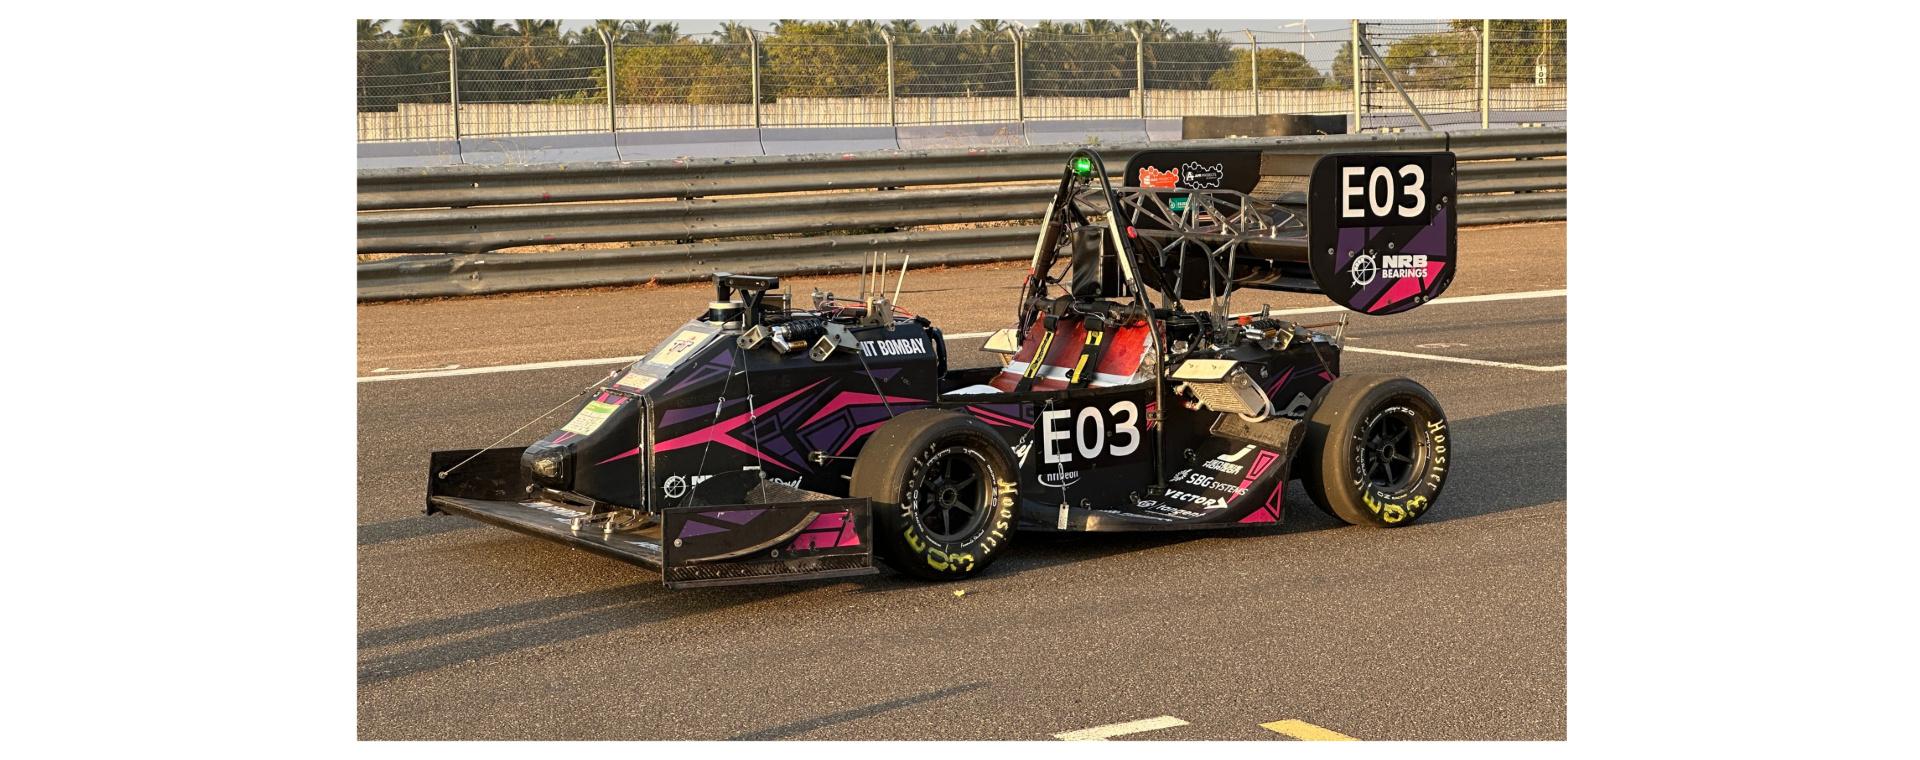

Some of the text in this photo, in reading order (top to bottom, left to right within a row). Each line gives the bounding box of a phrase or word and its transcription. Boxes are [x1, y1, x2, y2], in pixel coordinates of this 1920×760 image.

[1342, 164, 1426, 218] E03
[1382, 255, 1427, 268] NRB
[1382, 268, 1427, 278] BEARINGS
[877, 338, 926, 356] BOMBAY
[1042, 401, 1140, 464] E03
[1427, 418, 1447, 491] Hoosier
[1163, 488, 1215, 508] VECTOR
[1186, 473, 1249, 497] SBG SYSTEMS
[980, 478, 1019, 555] Hoosier
[903, 526, 975, 572] E03
